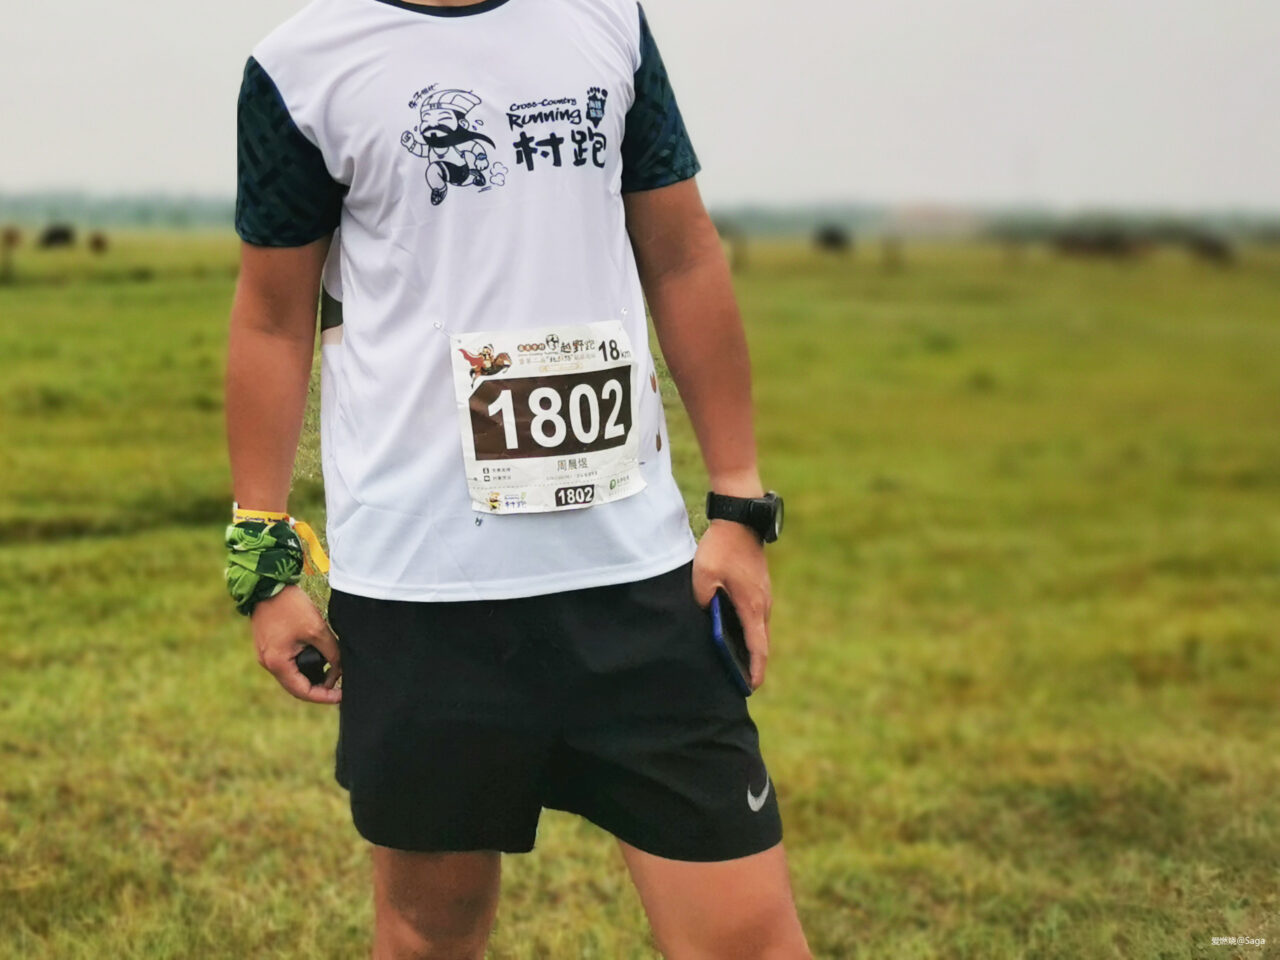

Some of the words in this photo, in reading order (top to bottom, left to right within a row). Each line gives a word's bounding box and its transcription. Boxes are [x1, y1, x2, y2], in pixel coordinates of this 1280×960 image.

[509, 97, 577, 112] Cross-Country
[505, 107, 583, 131] Running
[513, 126, 607, 172] 村跑
[488, 379, 625, 450] 1802
[558, 486, 593, 505] 1802
